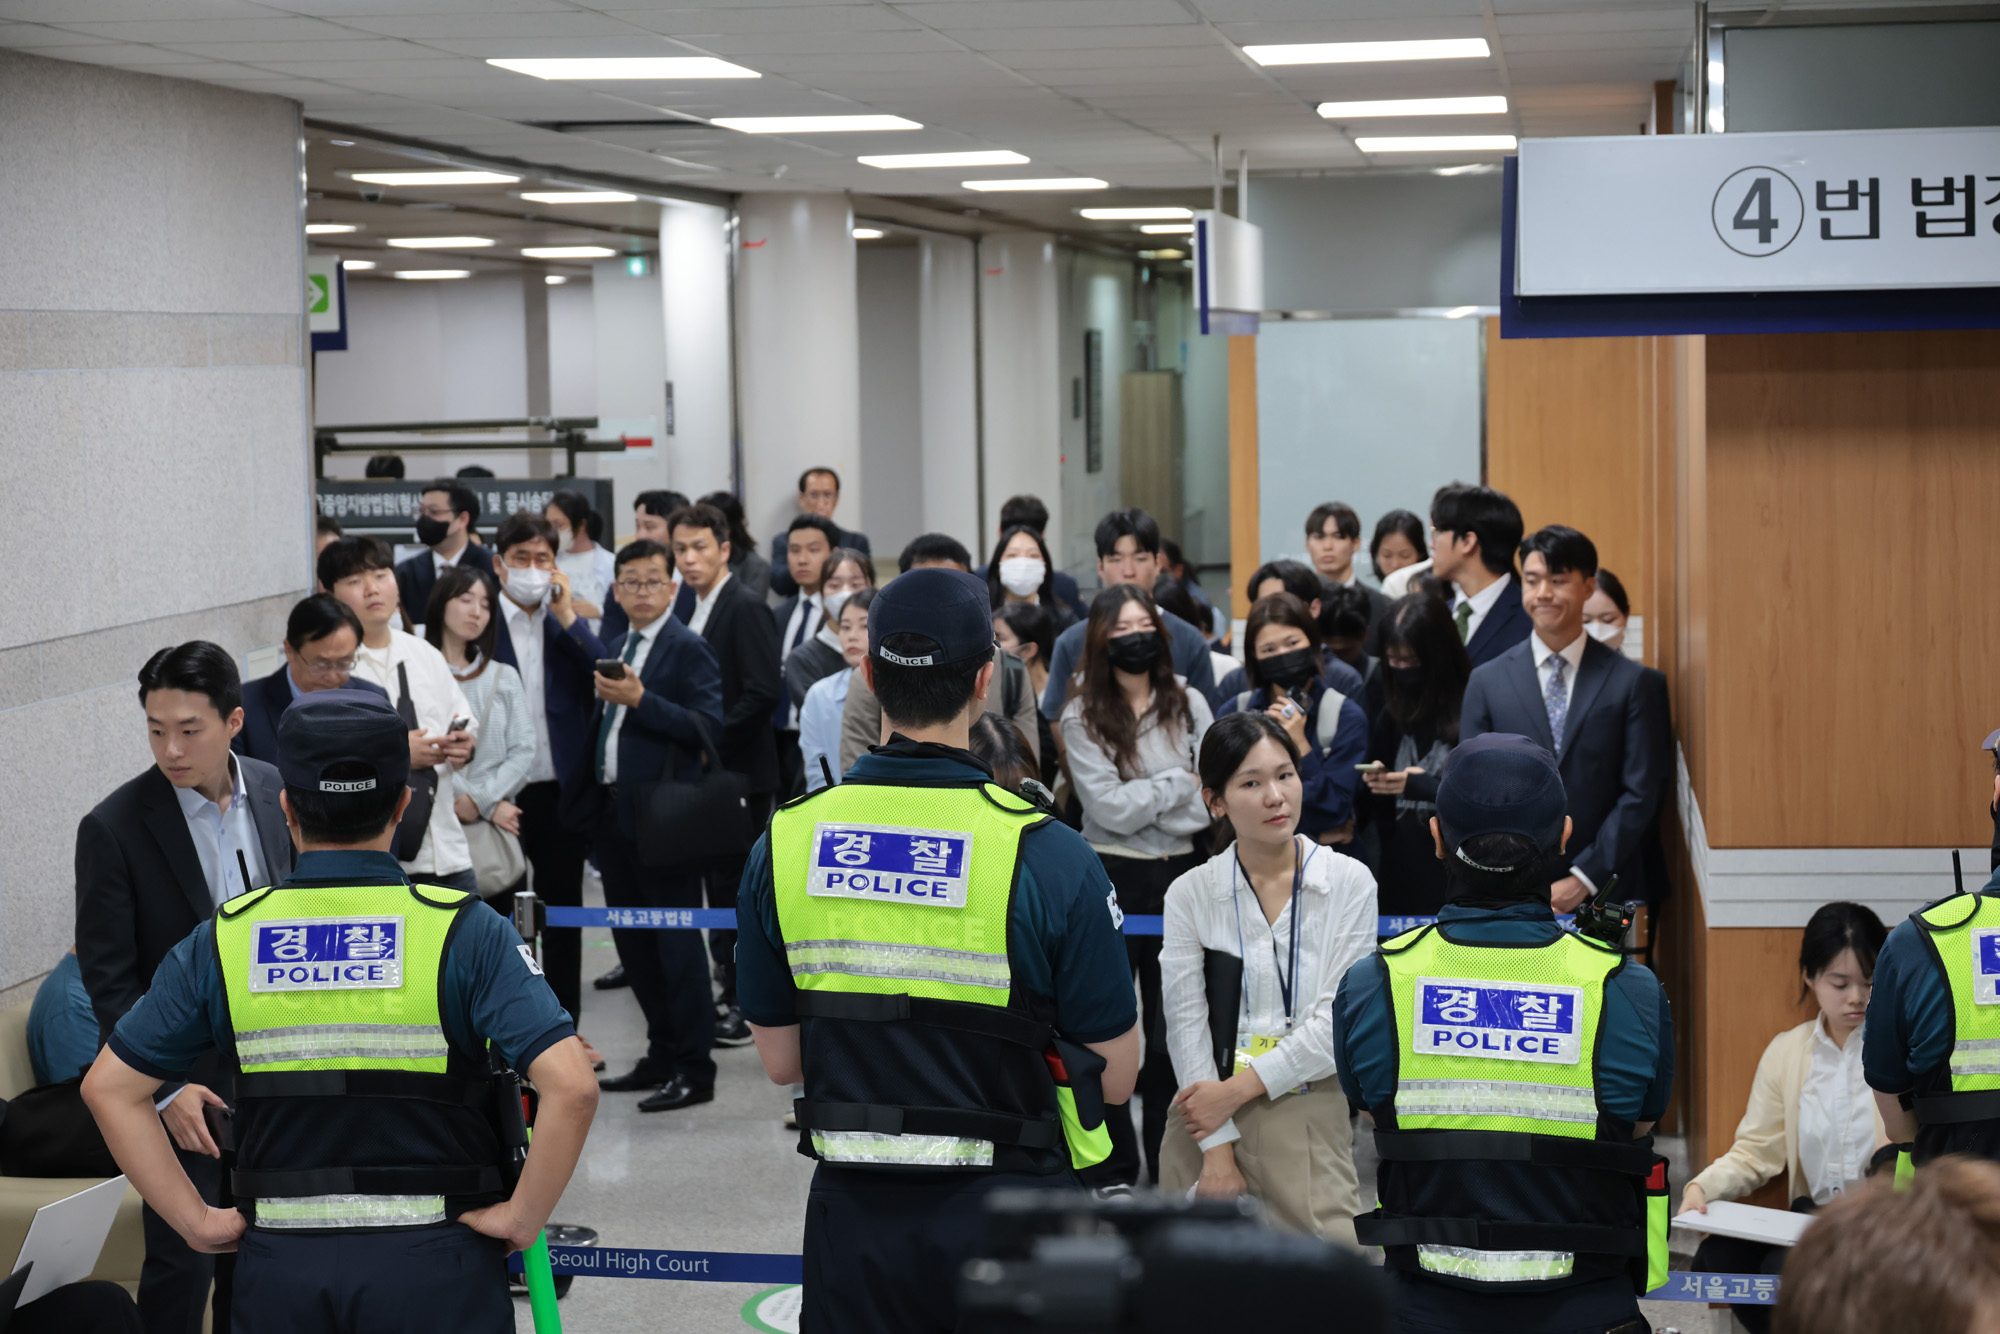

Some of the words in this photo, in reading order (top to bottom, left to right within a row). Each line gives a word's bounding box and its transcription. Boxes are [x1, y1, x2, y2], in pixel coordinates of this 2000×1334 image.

[1911, 174, 2000, 240] 법
[884, 650, 929, 666] POLICE
[324, 780, 373, 791] POLICE
[826, 872, 948, 899] POLICE
[606, 909, 693, 926] 서울고등법원
[267, 965, 384, 984] POLICE
[1433, 1030, 1559, 1055] POLICE
[549, 1249, 599, 1269] Seoul
[606, 1252, 650, 1274] High
[656, 1254, 709, 1273] Court
[1680, 1276, 1781, 1301] 서울고등
